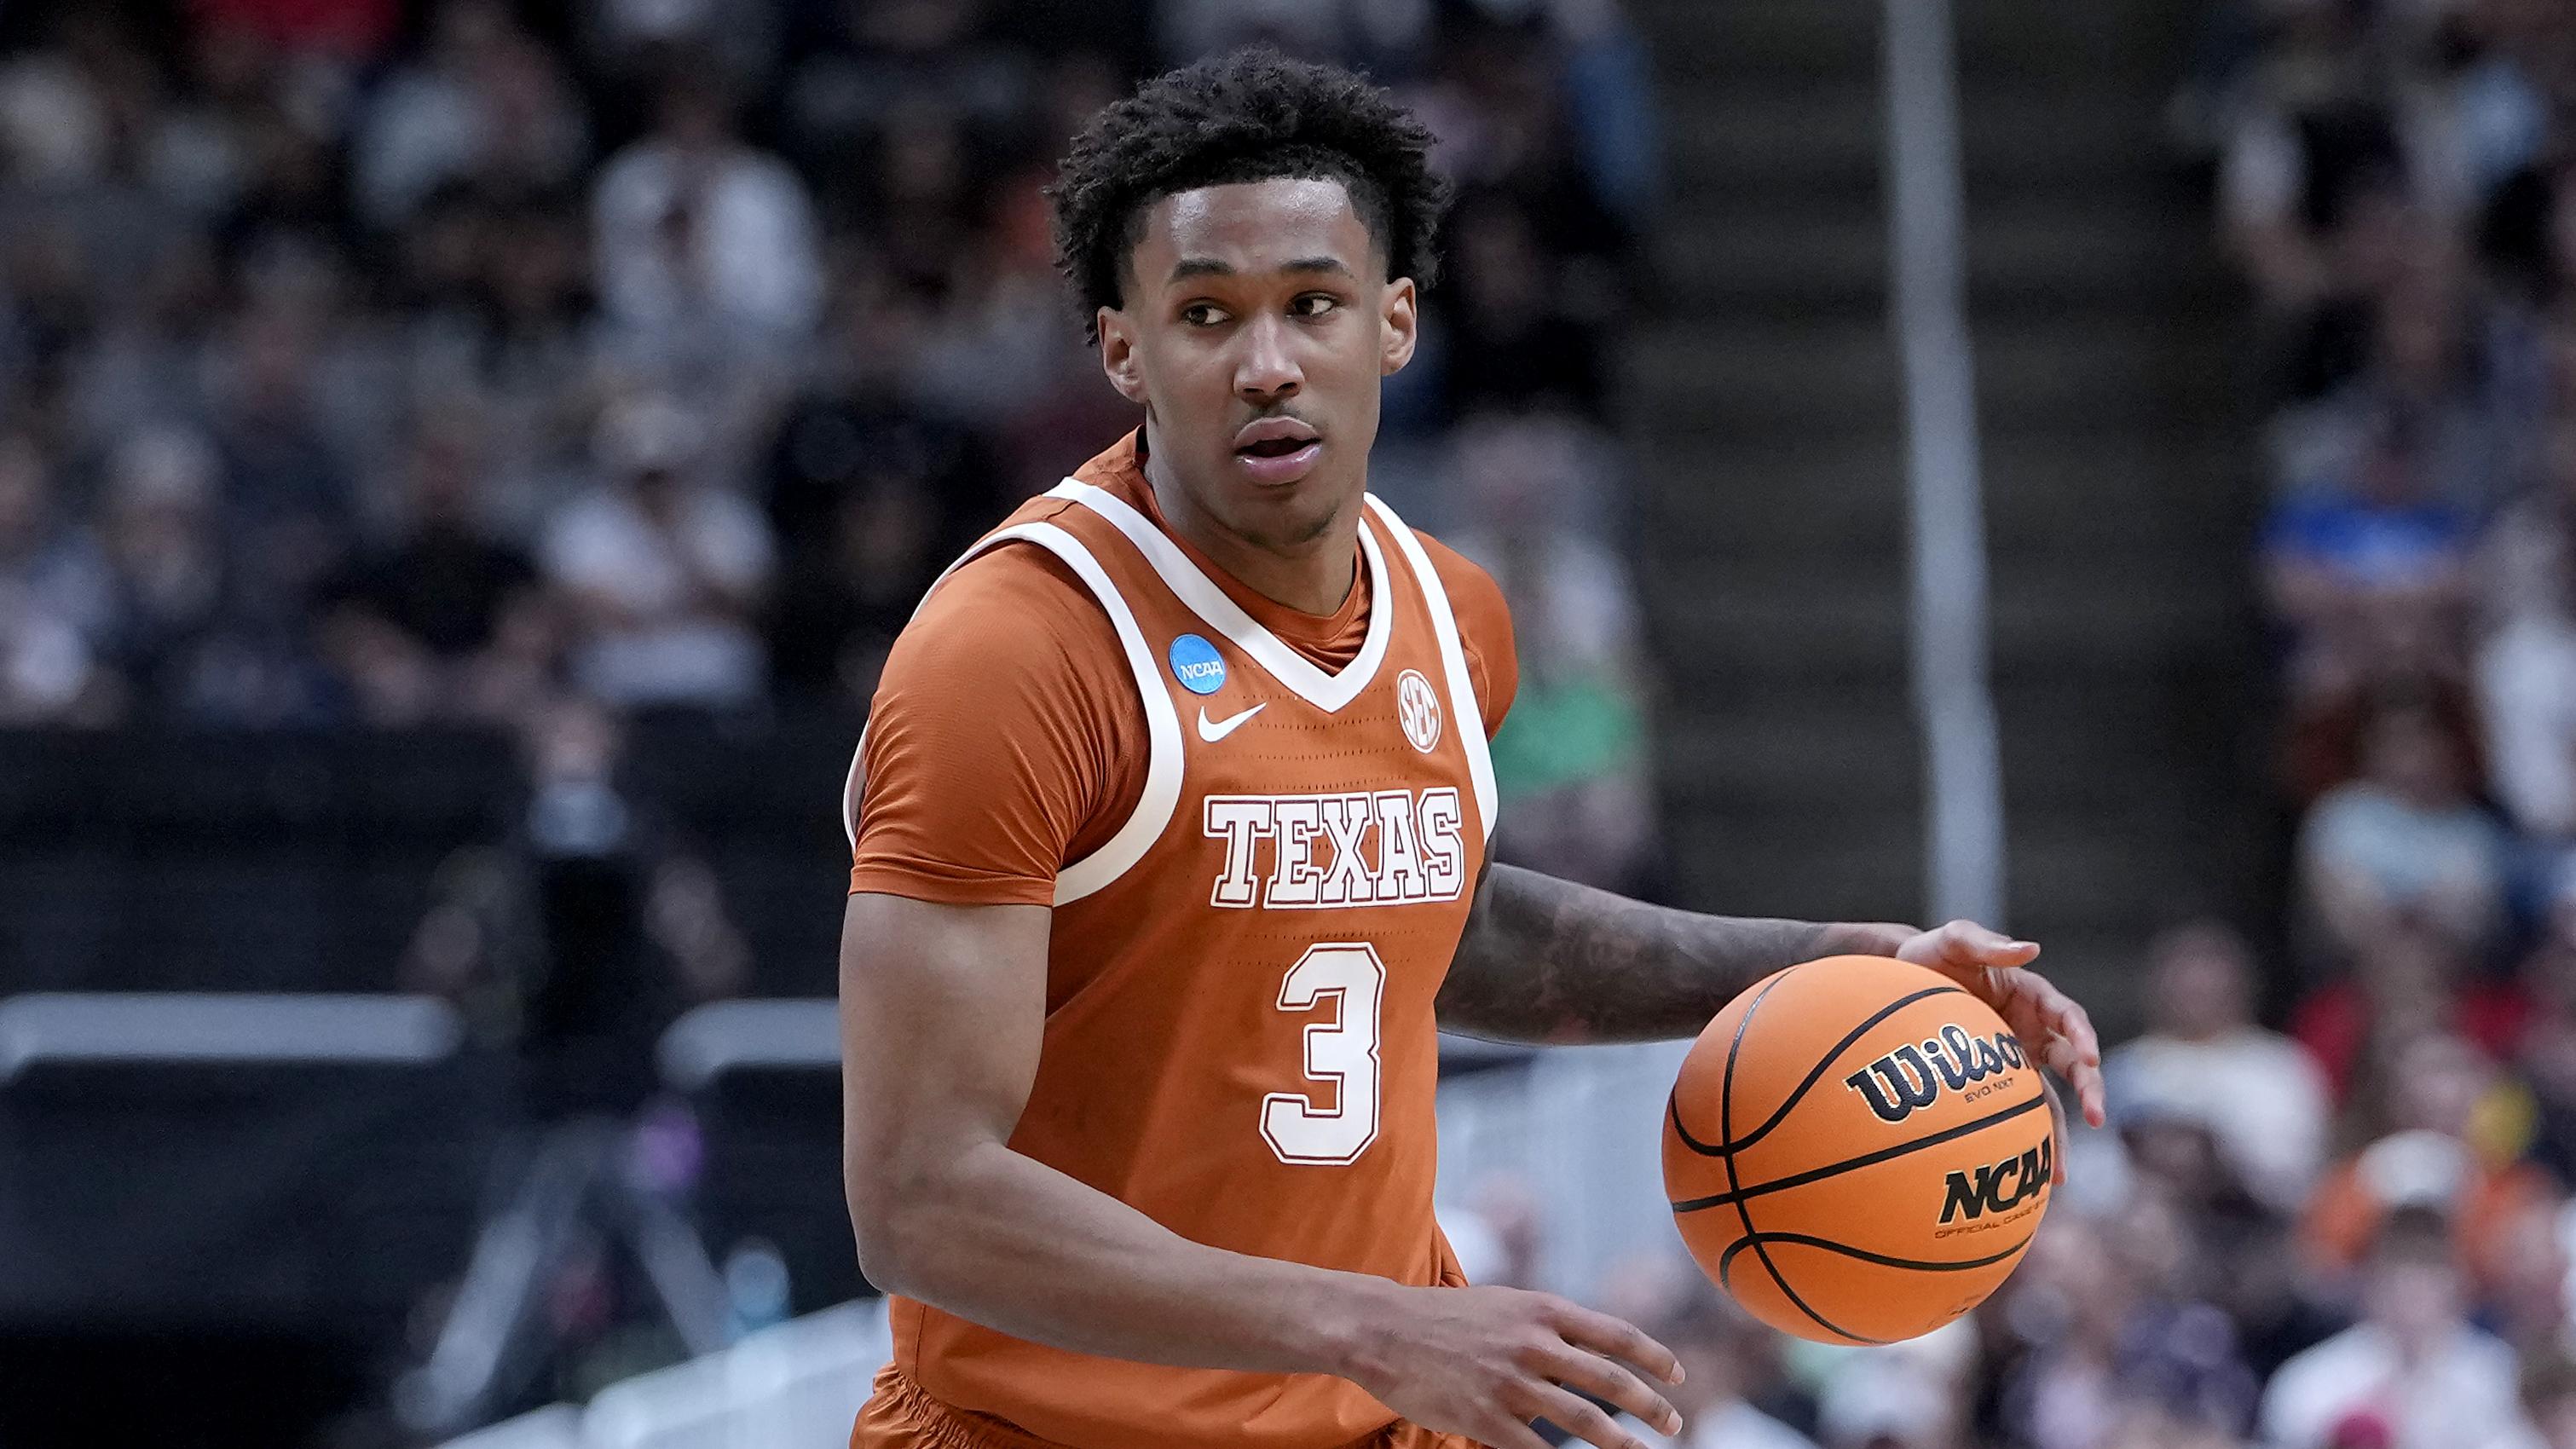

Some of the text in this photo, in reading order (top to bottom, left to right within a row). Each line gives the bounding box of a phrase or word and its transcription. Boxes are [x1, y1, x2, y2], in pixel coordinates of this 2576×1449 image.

[1180, 661, 1224, 680] NCAA
[1401, 676, 1437, 746] SEC
[1203, 787, 1464, 909] TEXAS
[1258, 942, 1387, 1165] 3
[1964, 1077, 2013, 1104] EVO NXT
[1936, 1134, 2051, 1226] NCAA
[1934, 1222, 2001, 1239] OFFICIAL
